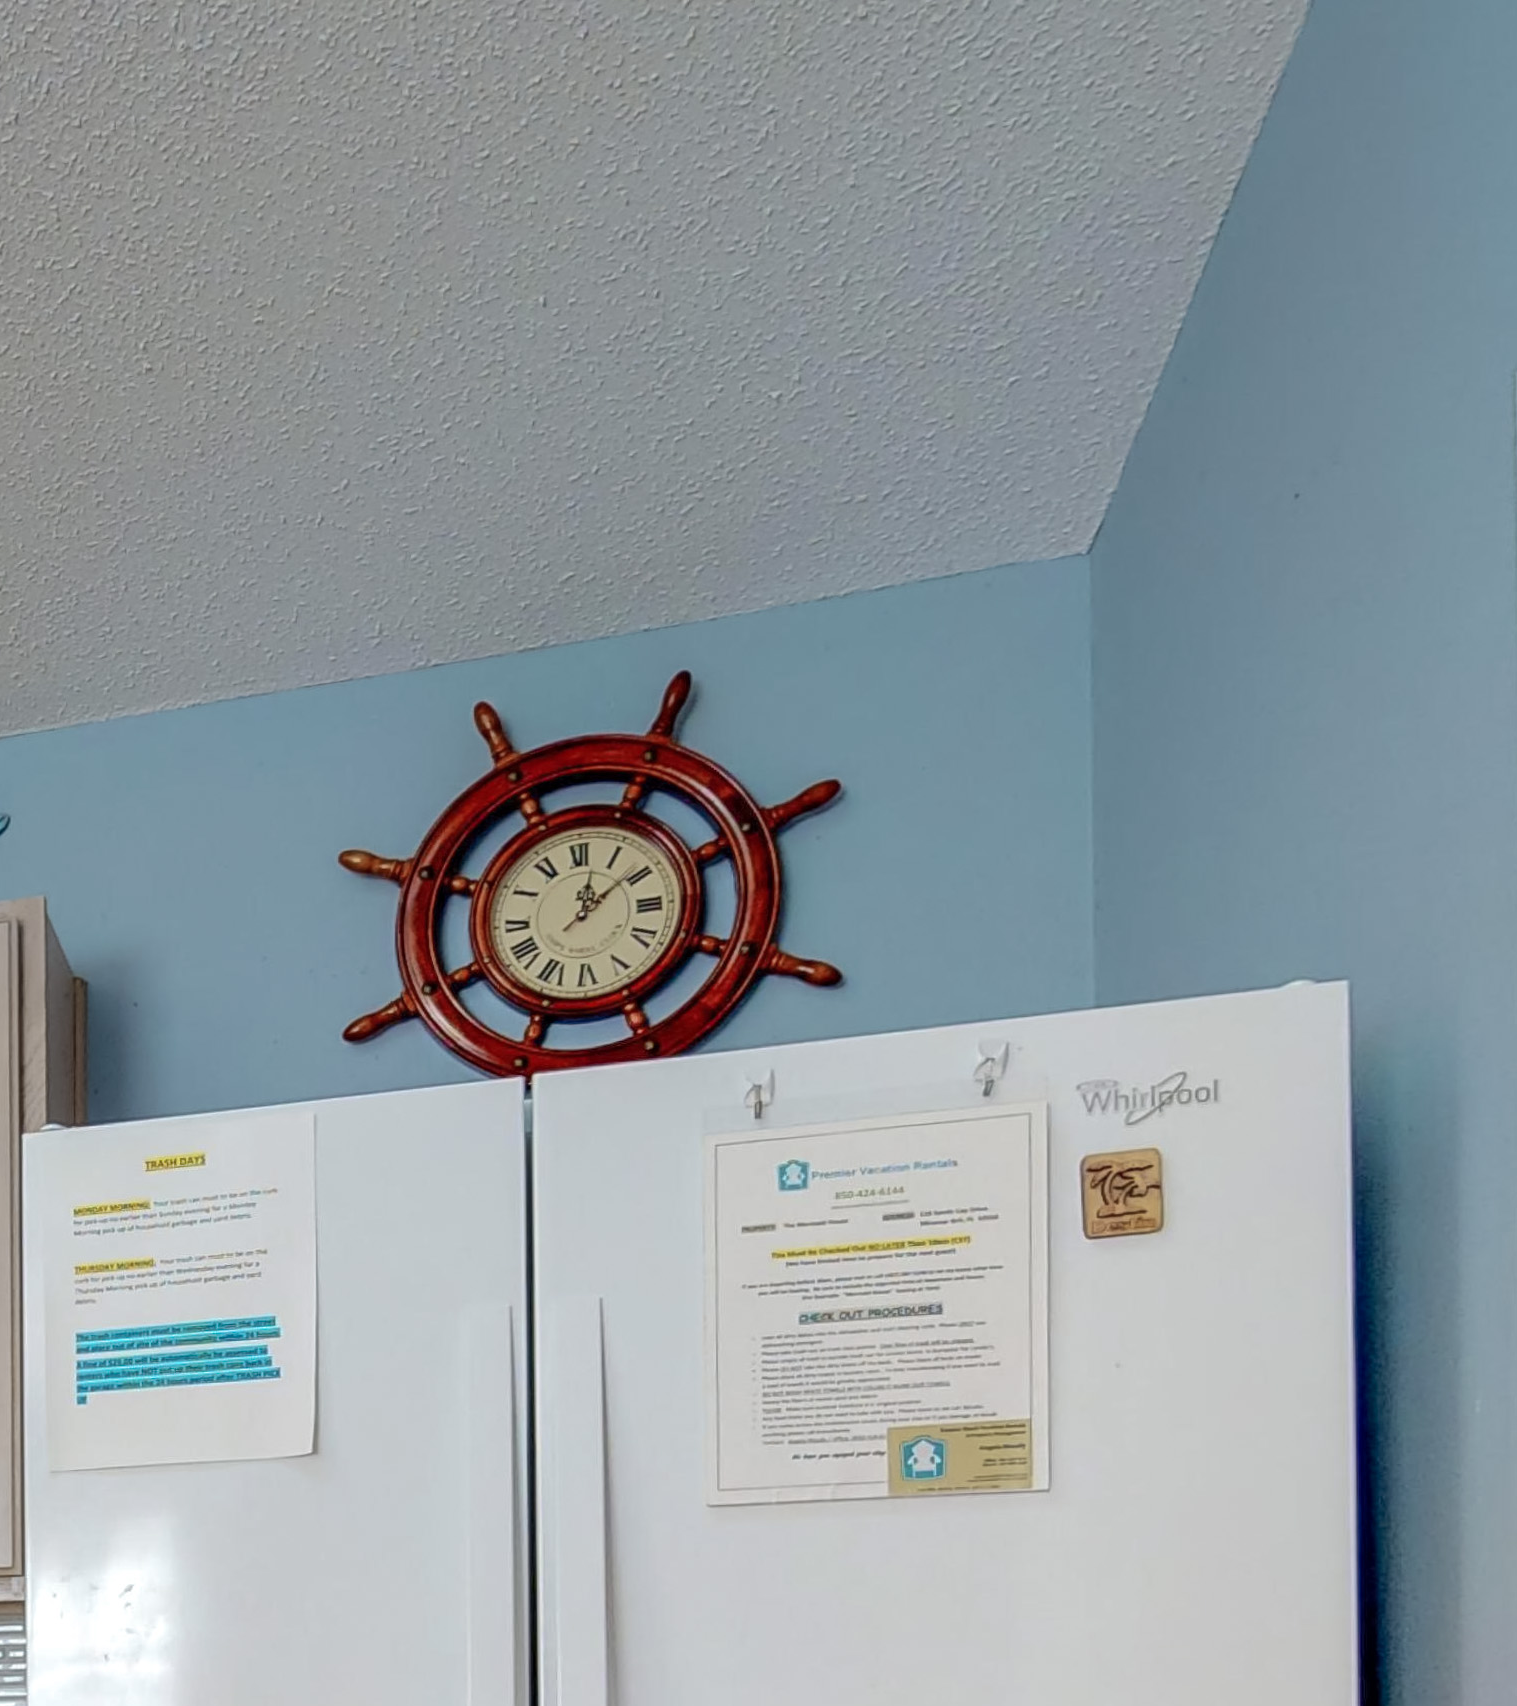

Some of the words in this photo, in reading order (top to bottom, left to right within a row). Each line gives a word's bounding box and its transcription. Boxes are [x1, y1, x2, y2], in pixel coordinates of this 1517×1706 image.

[1079, 1076, 1220, 1119] Whirlpool
[145, 1158, 177, 1171] TRASH
[179, 1155, 206, 1168] DAYS
[839, 1309, 864, 1320] OUT
